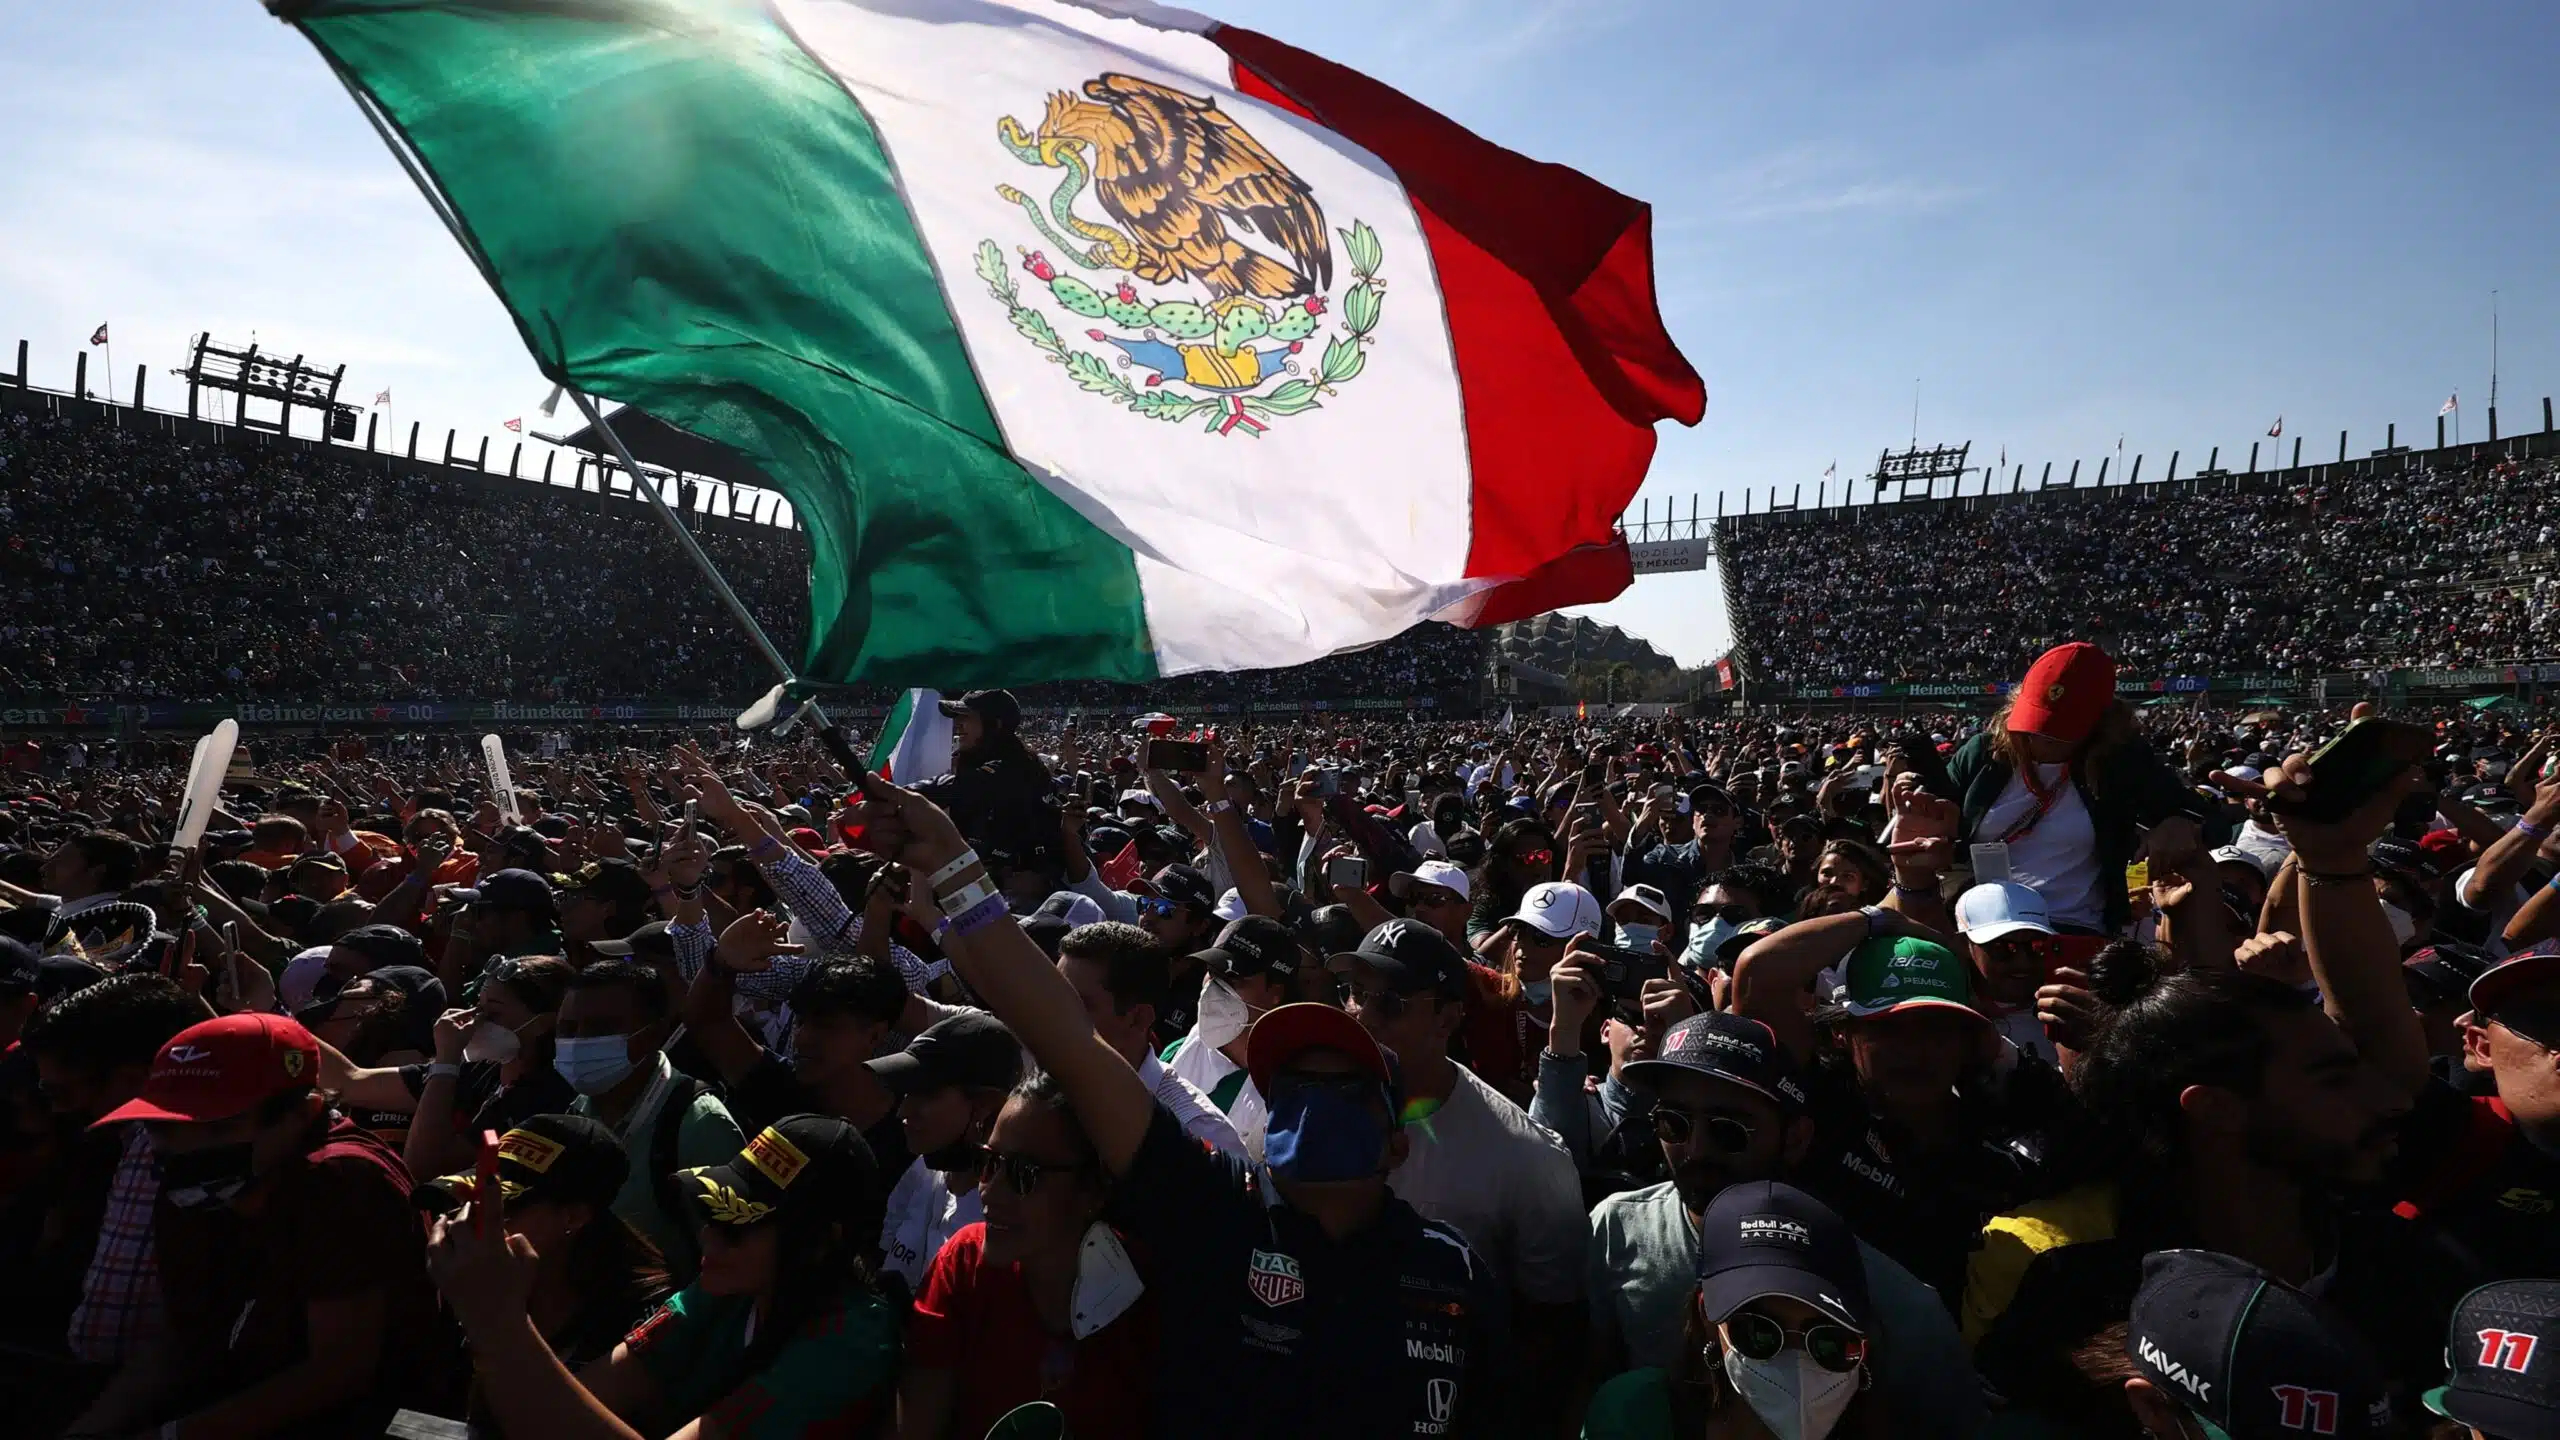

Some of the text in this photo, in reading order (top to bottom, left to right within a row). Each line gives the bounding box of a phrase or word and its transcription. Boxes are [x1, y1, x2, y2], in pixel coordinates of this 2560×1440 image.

[1652, 548, 1668, 557] DE
[1674, 546, 1689, 555] LA
[2425, 669, 2497, 685] Heineken
[1909, 684, 1980, 696] Heineken
[493, 704, 585, 720] Heineken
[1253, 701, 1299, 712] Heineken
[1354, 698, 1403, 709] Heineken
[236, 704, 365, 722] Heineken
[1373, 922, 1407, 949] NY
[1888, 954, 1939, 971] telcel
[1903, 976, 1950, 990] PEMEX
[1662, 1028, 1740, 1057] 11 Red Bull
[1777, 1076, 1809, 1104] telcel
[1842, 1151, 1896, 1191] Mobil
[1741, 1219, 1777, 1230] Red Bull
[1741, 1231, 1811, 1245] RACING
[1256, 1253, 1301, 1279] TAG
[1250, 1271, 1302, 1302] HEUER
[1405, 1338, 1454, 1364] Mobil
[2475, 1327, 2540, 1375] 11
[2138, 1335, 2212, 1403] KAVAK
[2269, 1383, 2340, 1435] 11
